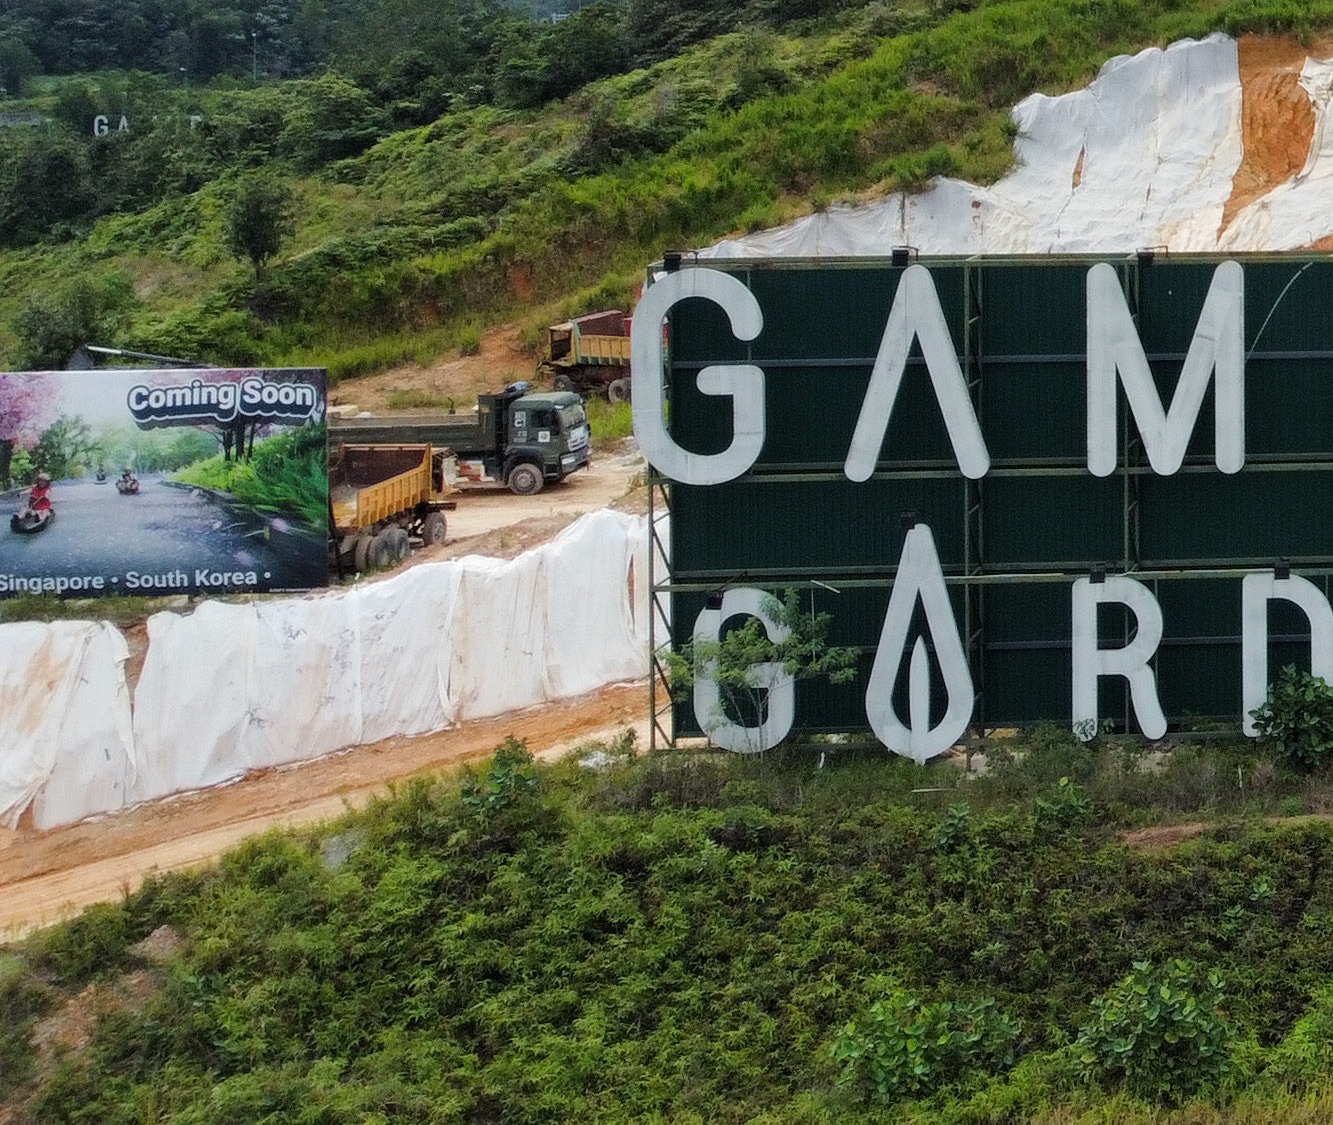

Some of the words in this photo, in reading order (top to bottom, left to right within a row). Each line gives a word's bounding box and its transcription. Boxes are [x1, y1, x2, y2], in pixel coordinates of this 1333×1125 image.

[128, 381, 235, 411] Coming
[242, 380, 313, 406] Soon
[125, 571, 189, 590] South
[194, 568, 258, 587] Korea
